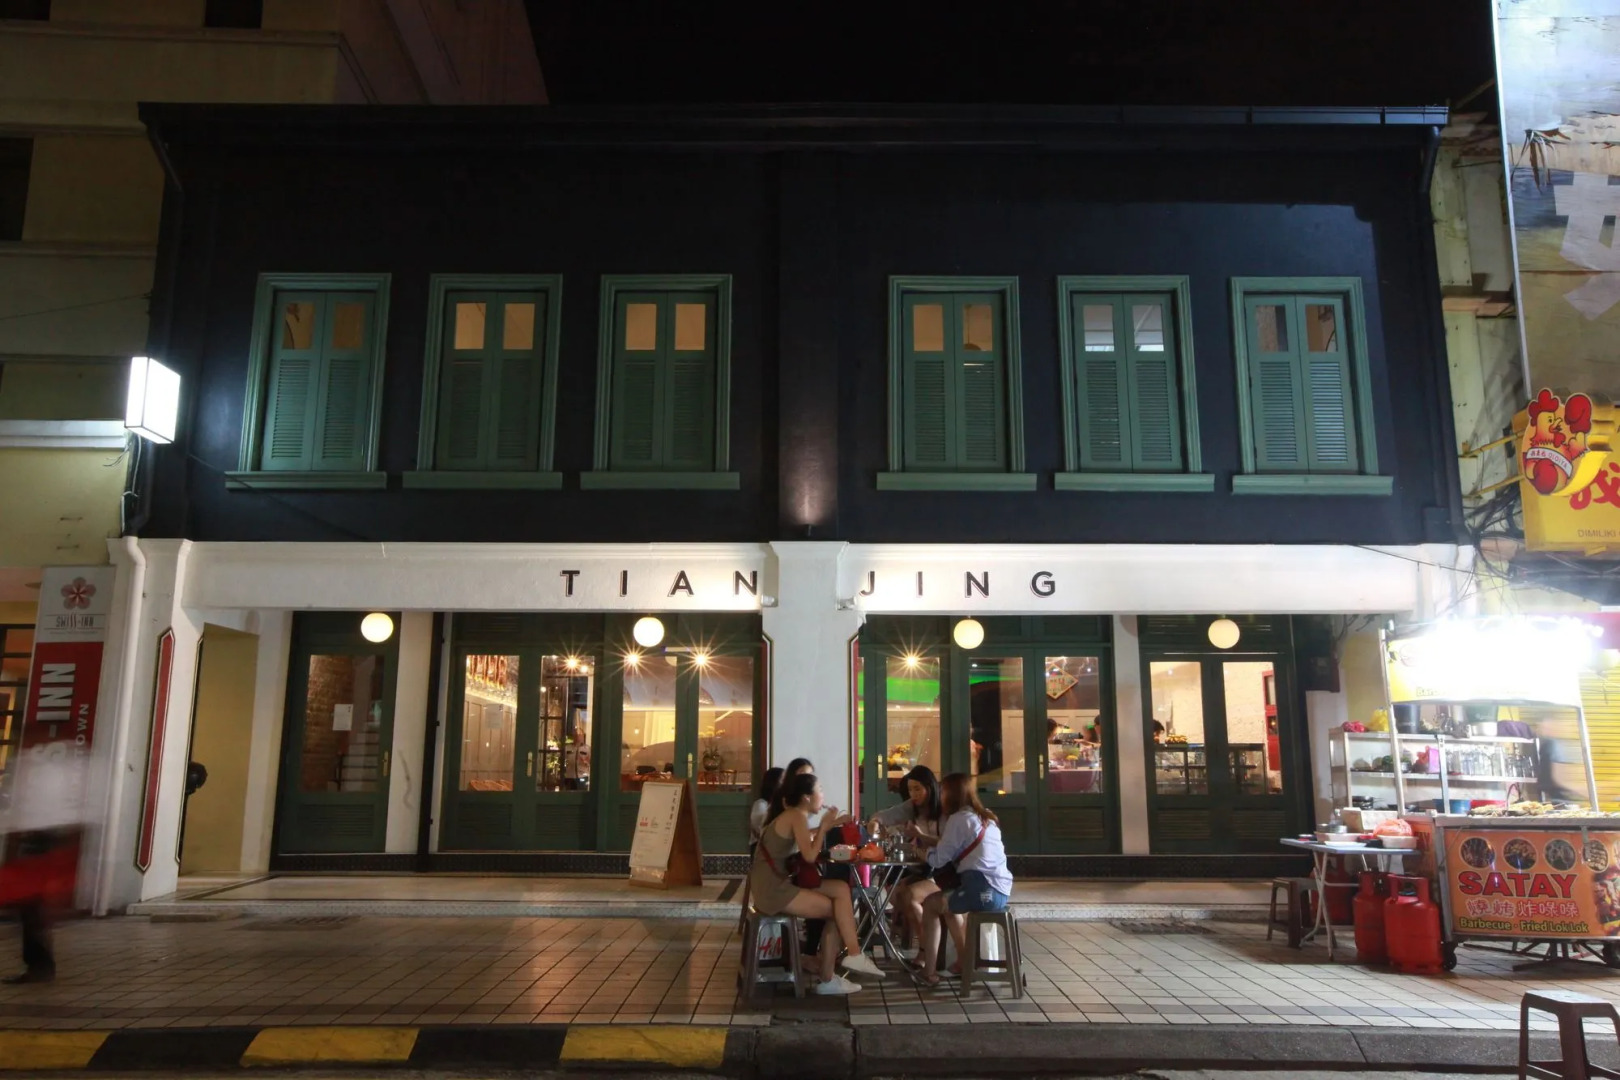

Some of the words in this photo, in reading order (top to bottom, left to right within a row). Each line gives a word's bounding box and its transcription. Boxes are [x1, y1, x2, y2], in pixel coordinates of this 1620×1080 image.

[1577, 528, 1616, 538] DIMILIKI
[560, 570, 758, 598] TIAN
[859, 570, 1057, 599] JING
[1458, 870, 1577, 898] SATAY
[1460, 918, 1512, 931] Barbecue
[1520, 921, 1548, 932] Fried
[1550, 922, 1569, 933] Lok
[1570, 922, 1589, 934] Lok
